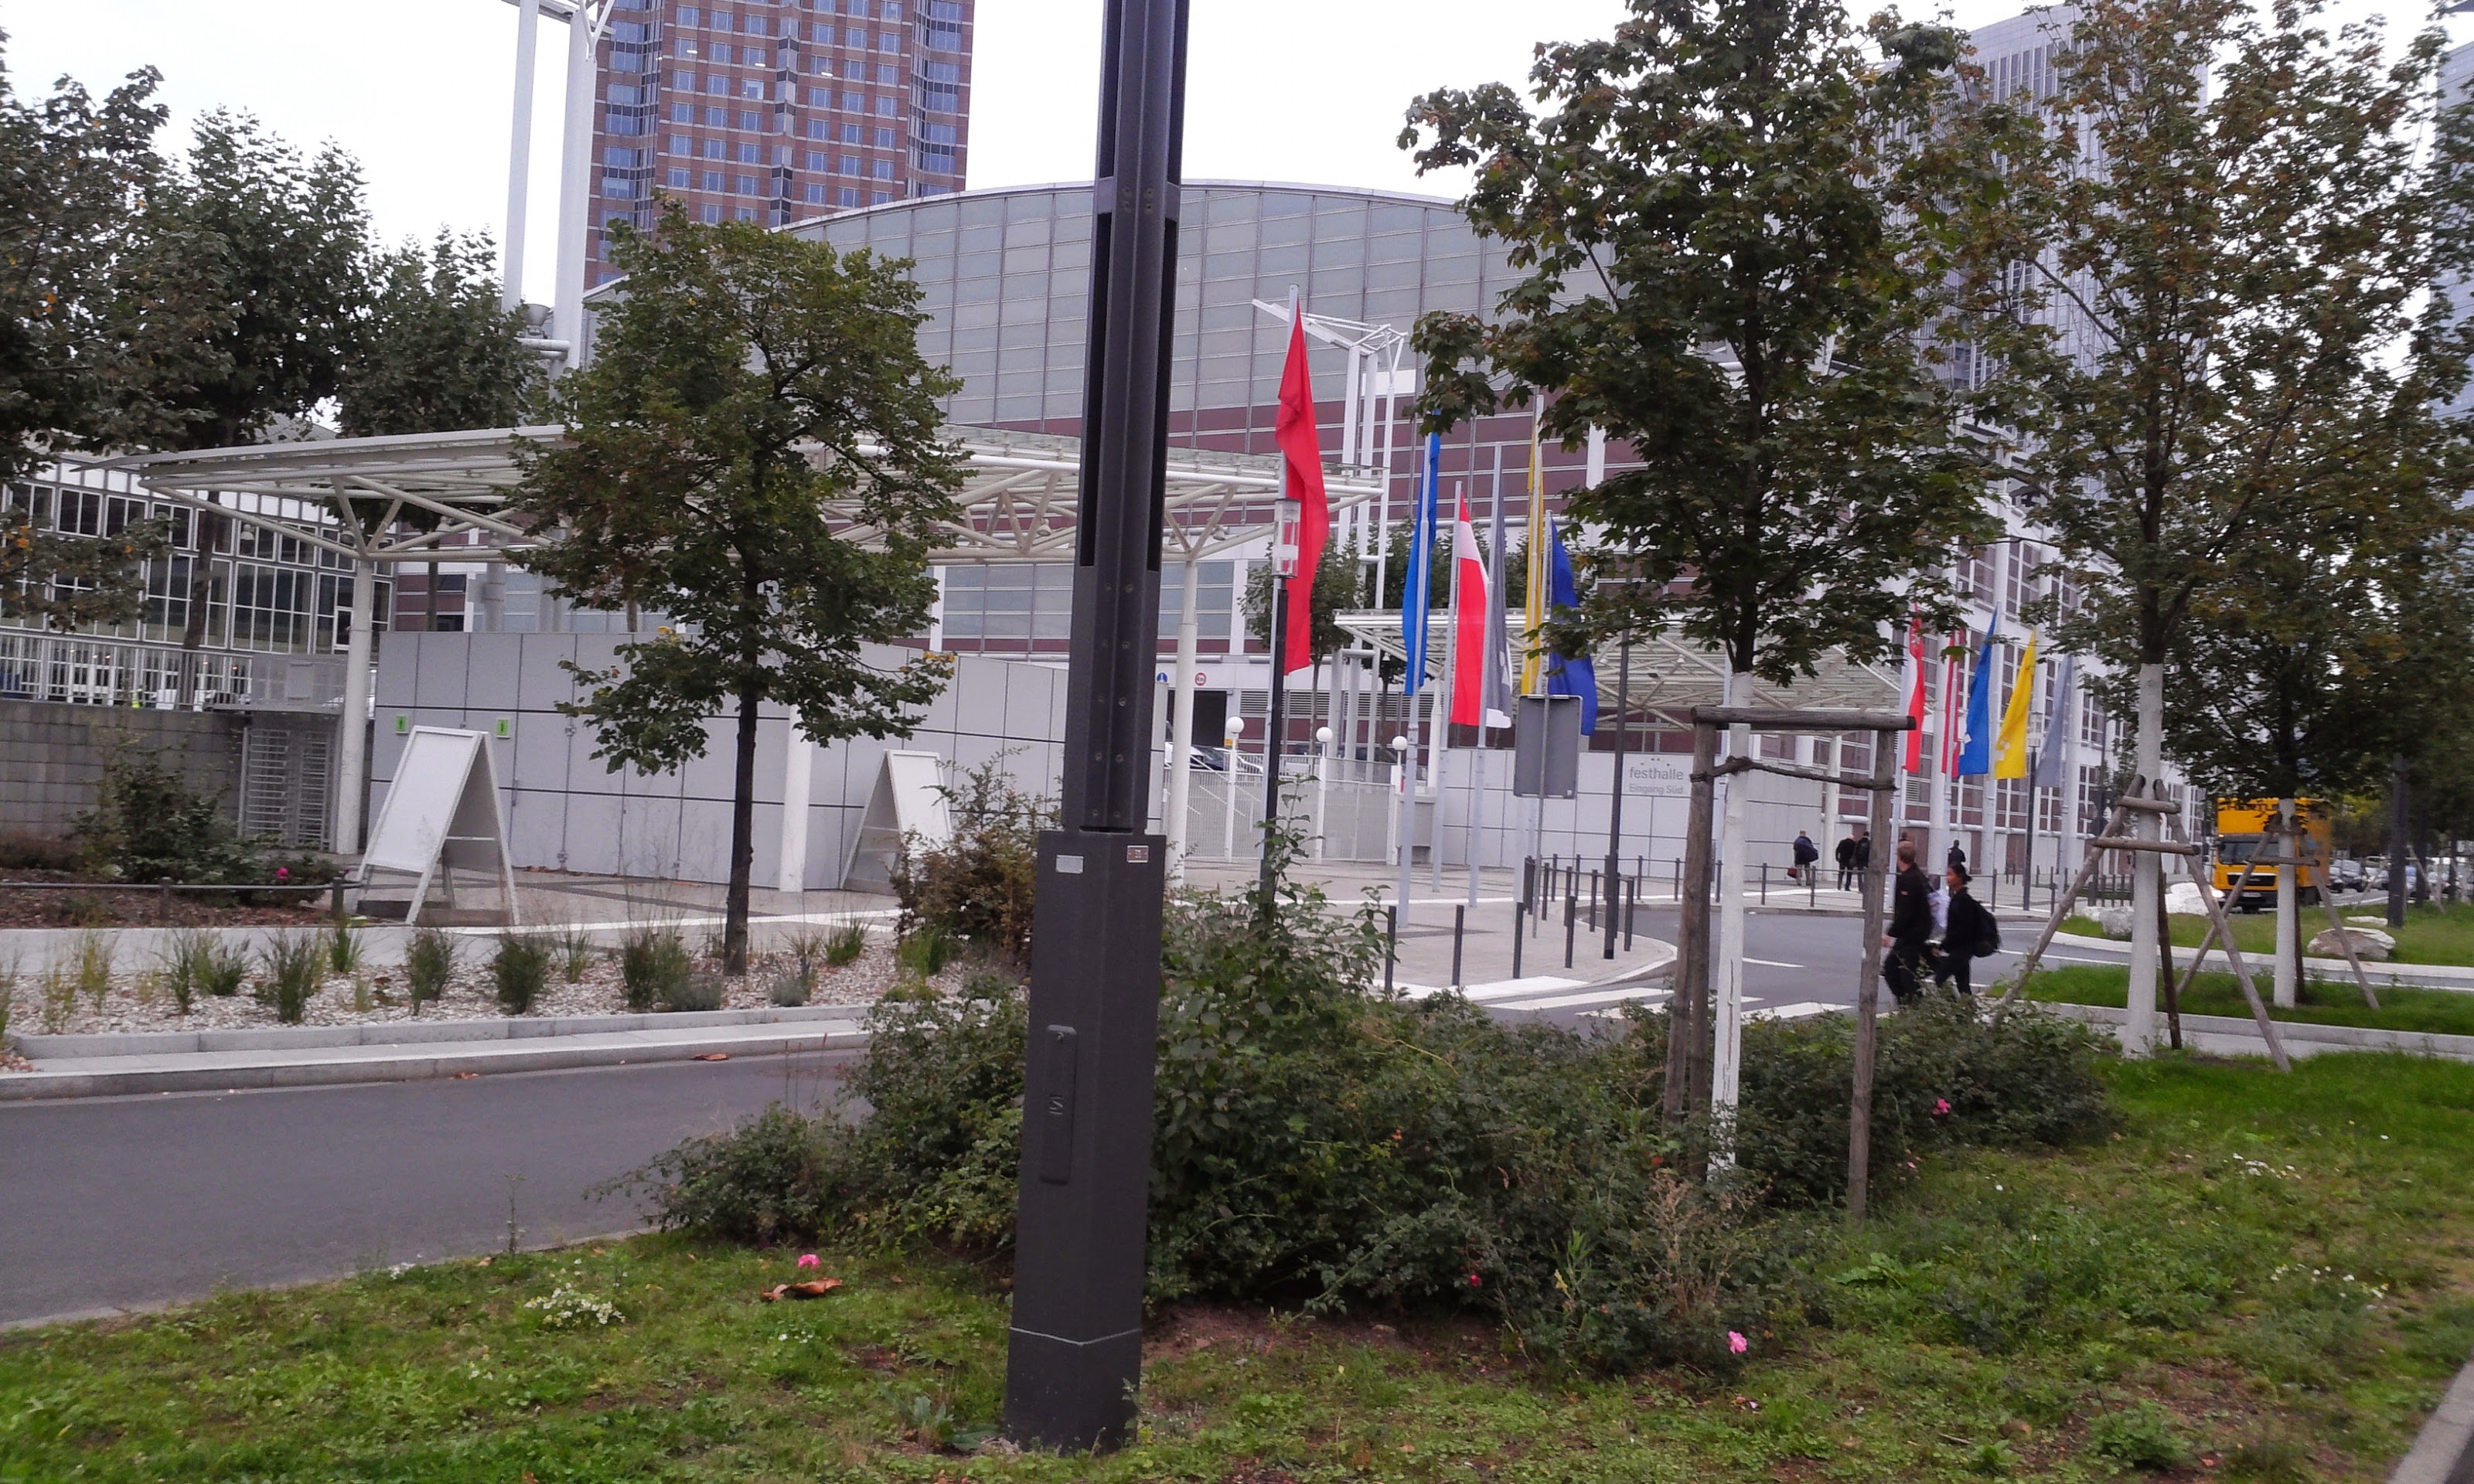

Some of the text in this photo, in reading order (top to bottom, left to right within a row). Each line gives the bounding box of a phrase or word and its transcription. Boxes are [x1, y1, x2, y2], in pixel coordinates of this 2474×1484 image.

[1629, 767, 1683, 780] festhalle
[1629, 784, 1683, 795] Eingang Süd
